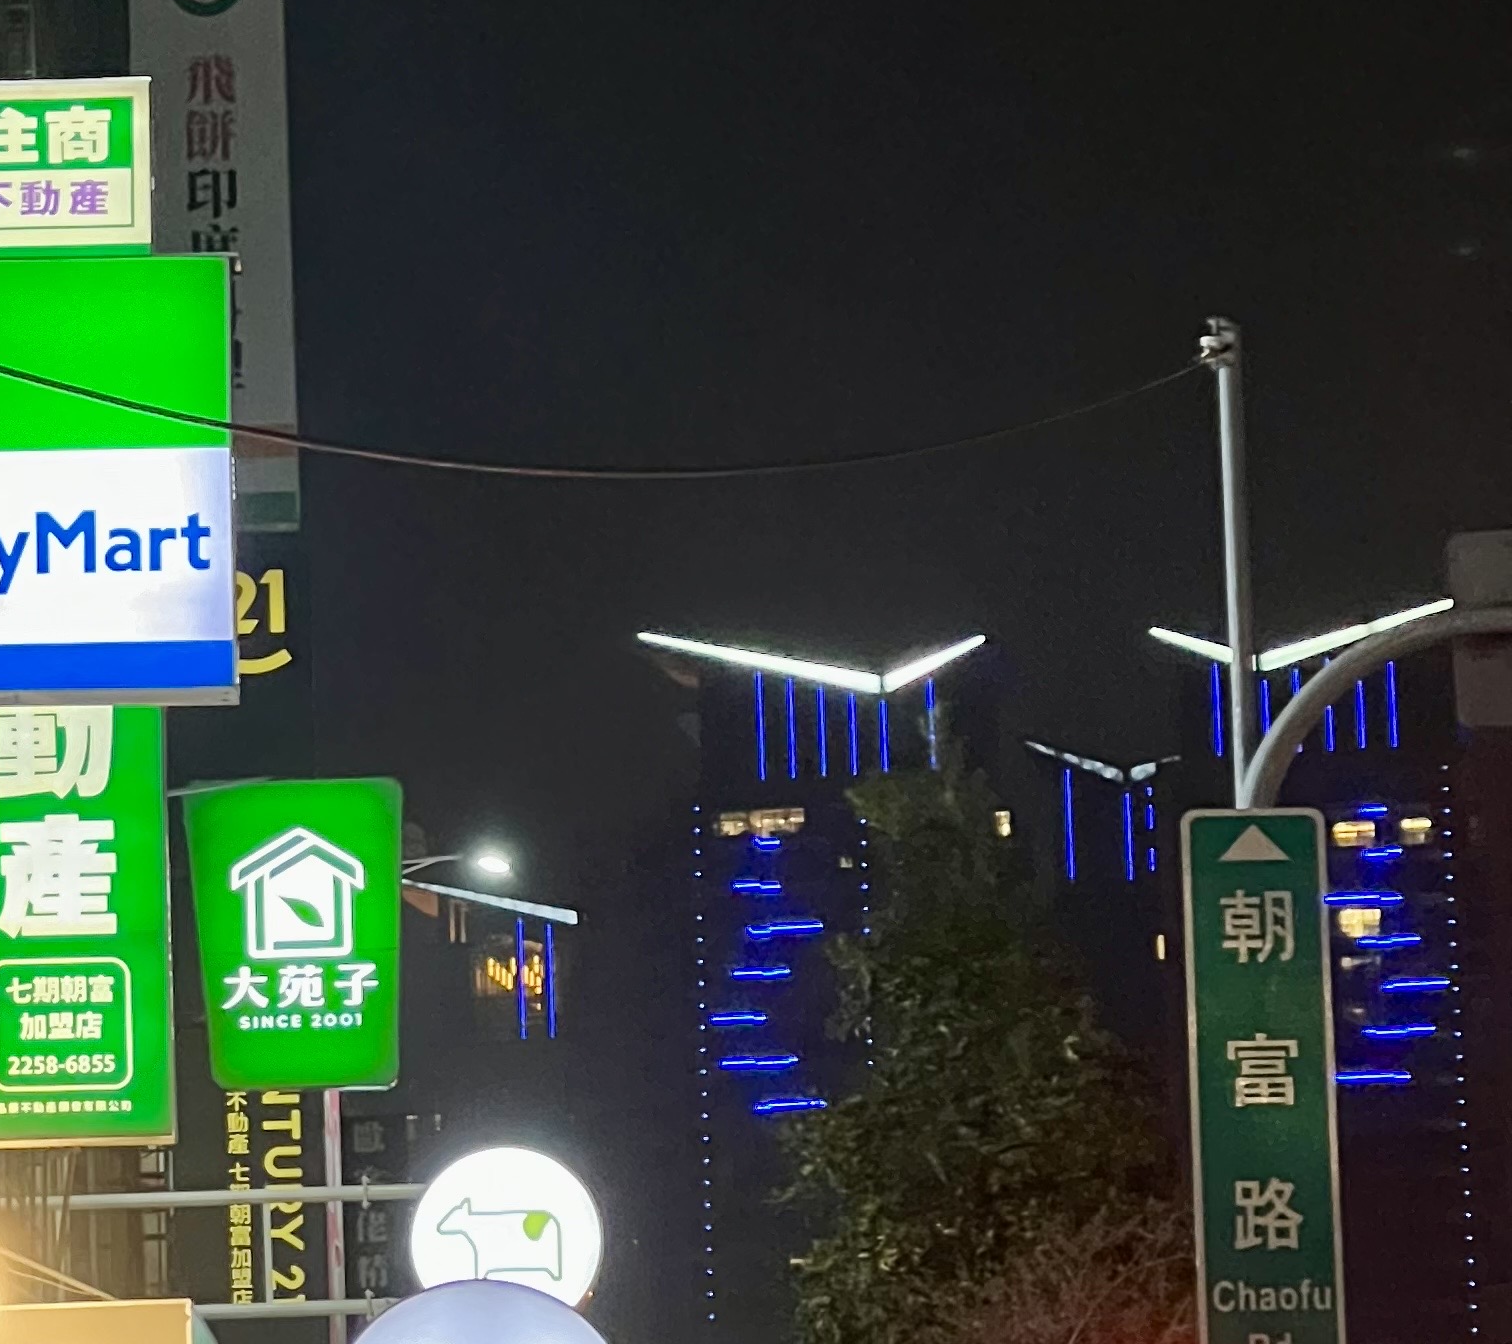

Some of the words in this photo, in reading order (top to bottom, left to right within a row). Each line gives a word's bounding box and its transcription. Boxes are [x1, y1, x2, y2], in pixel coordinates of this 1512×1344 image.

[4, 974, 116, 1005] 七期朝富
[221, 962, 380, 1010] 大苑子
[19, 1011, 103, 1041] 加盟店
[239, 1014, 303, 1030] SINCE
[310, 1012, 364, 1029] 2001
[7, 1053, 116, 1076] 2258-6855
[1219, 889, 1304, 1252] 朝富路
[1213, 1279, 1332, 1314] Chaofu
